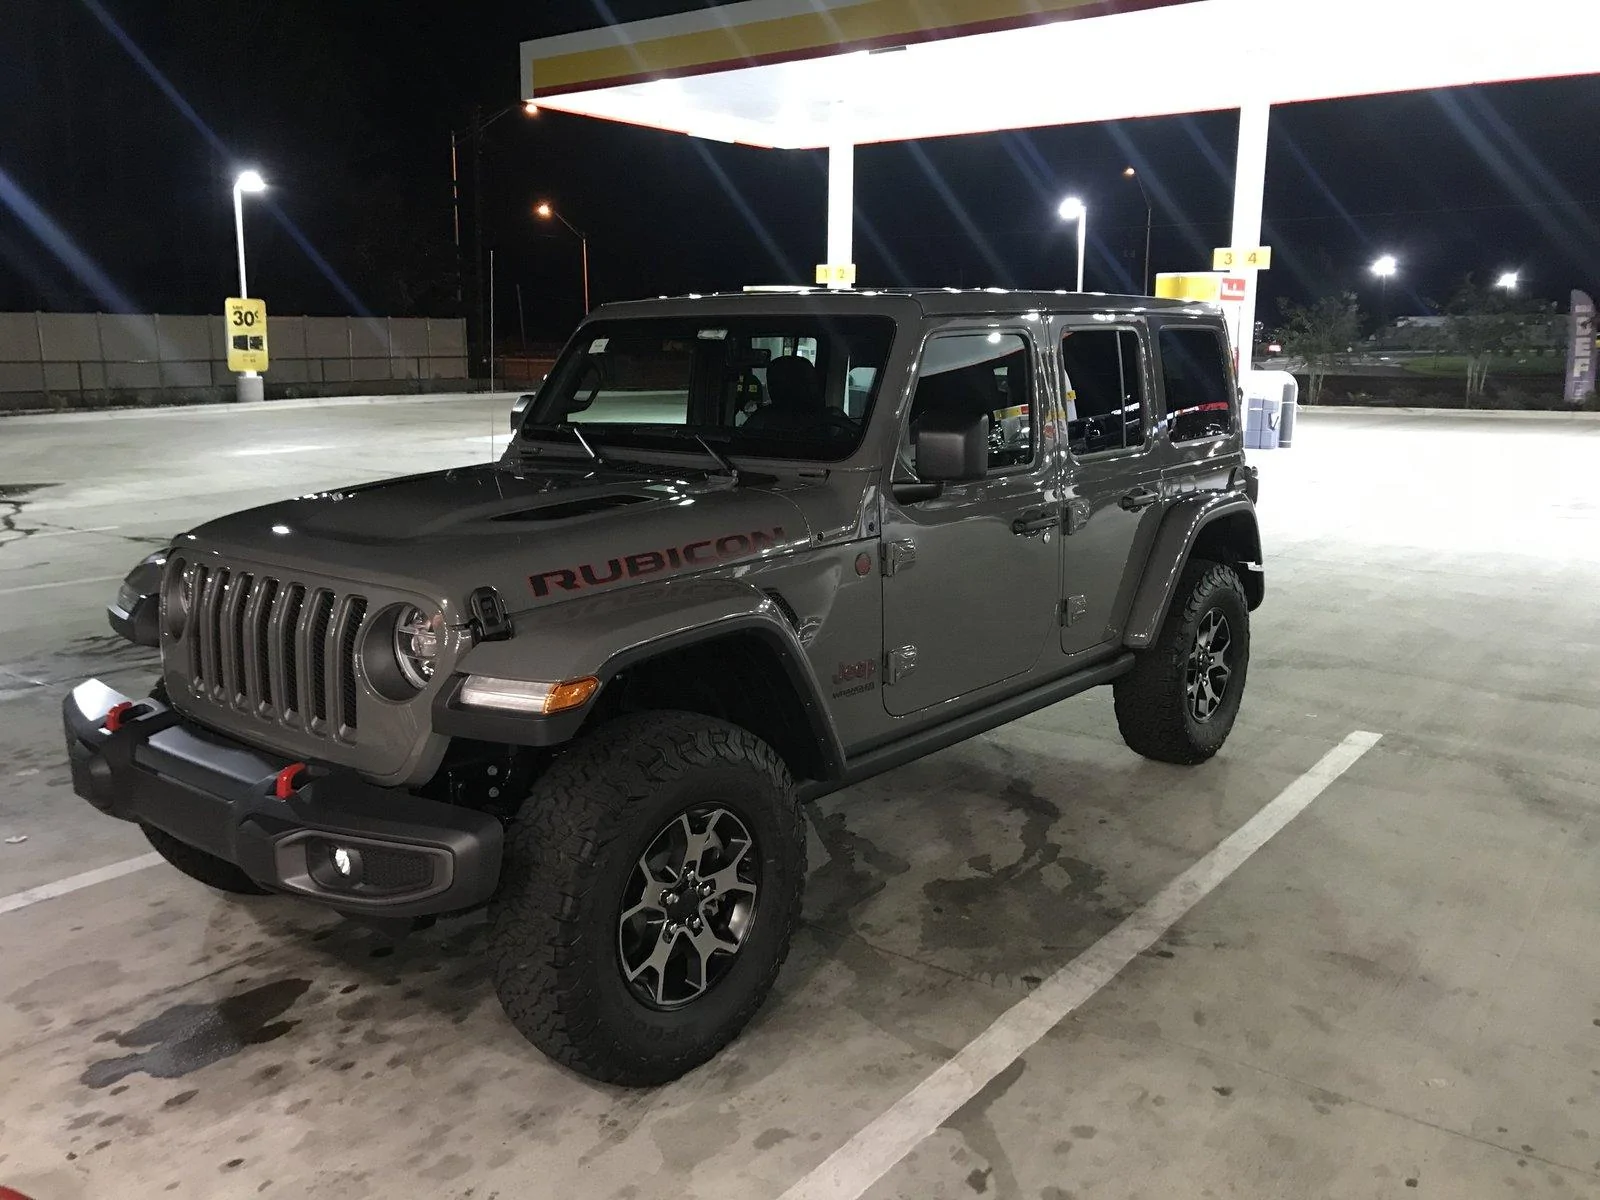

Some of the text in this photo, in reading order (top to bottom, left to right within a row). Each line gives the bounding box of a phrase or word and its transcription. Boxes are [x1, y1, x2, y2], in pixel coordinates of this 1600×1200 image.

[1224, 252, 1257, 265] 3 4
[528, 527, 785, 597] RUBICON
